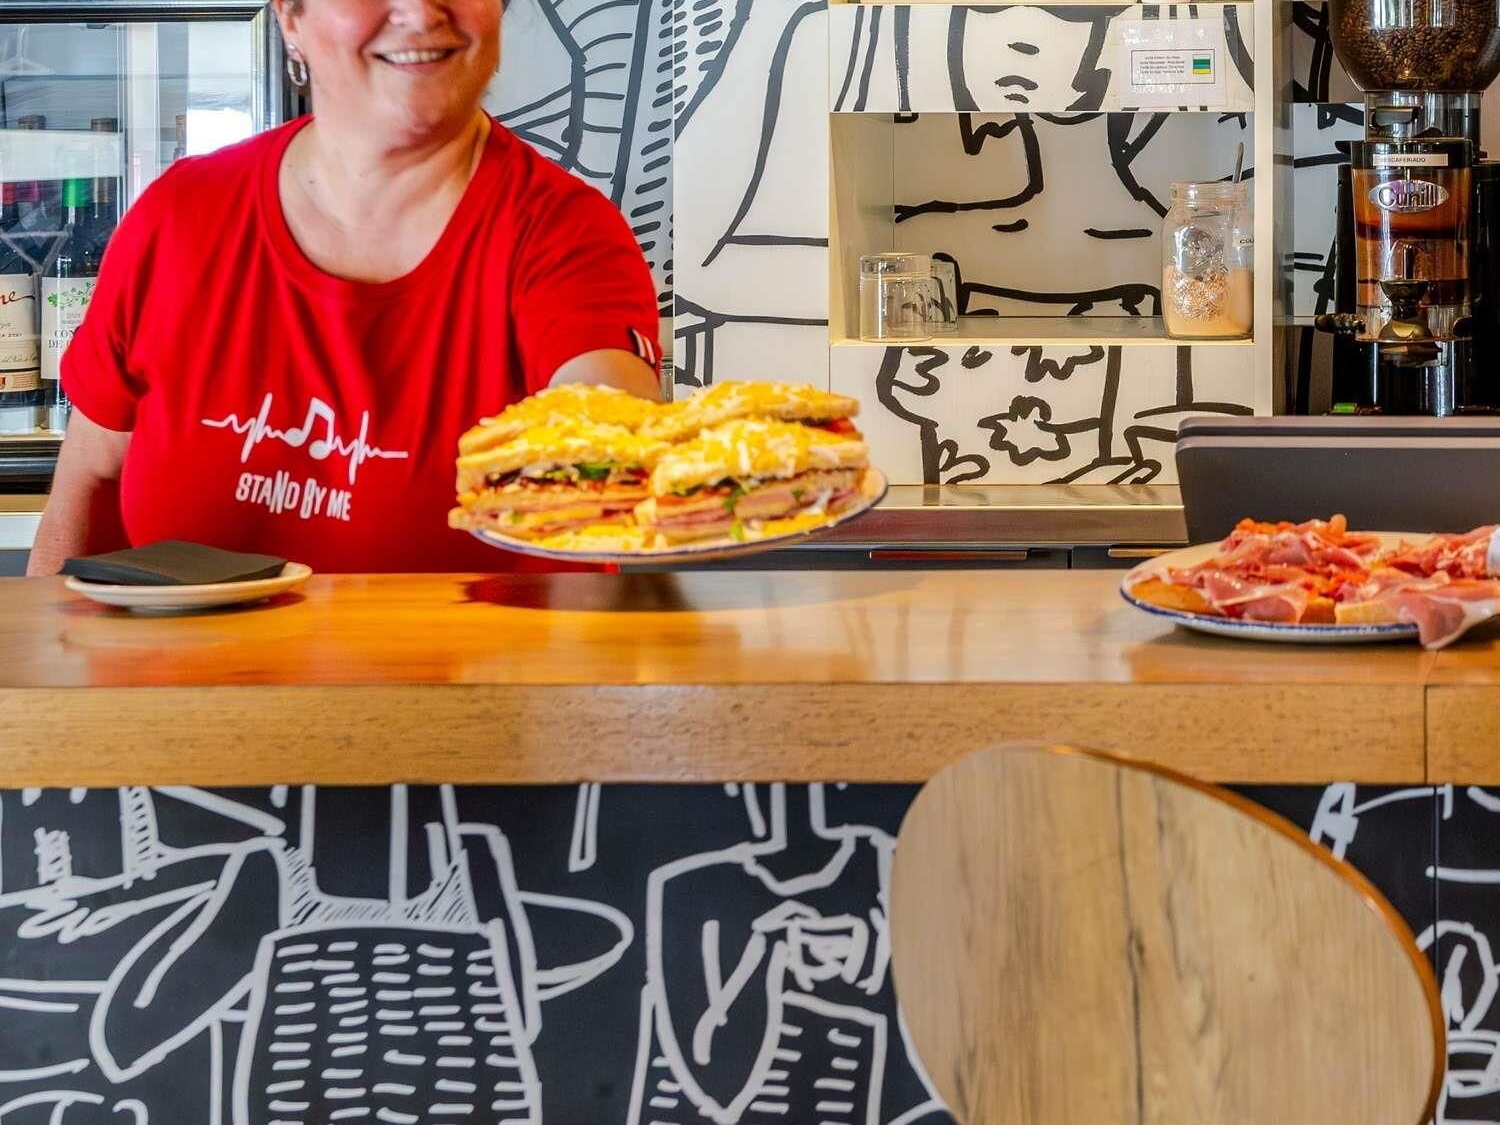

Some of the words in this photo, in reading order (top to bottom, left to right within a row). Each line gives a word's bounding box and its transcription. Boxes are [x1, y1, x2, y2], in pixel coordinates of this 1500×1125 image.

[235, 469, 301, 515] STAND
[300, 477, 328, 520] BY
[326, 488, 353, 522] ME
